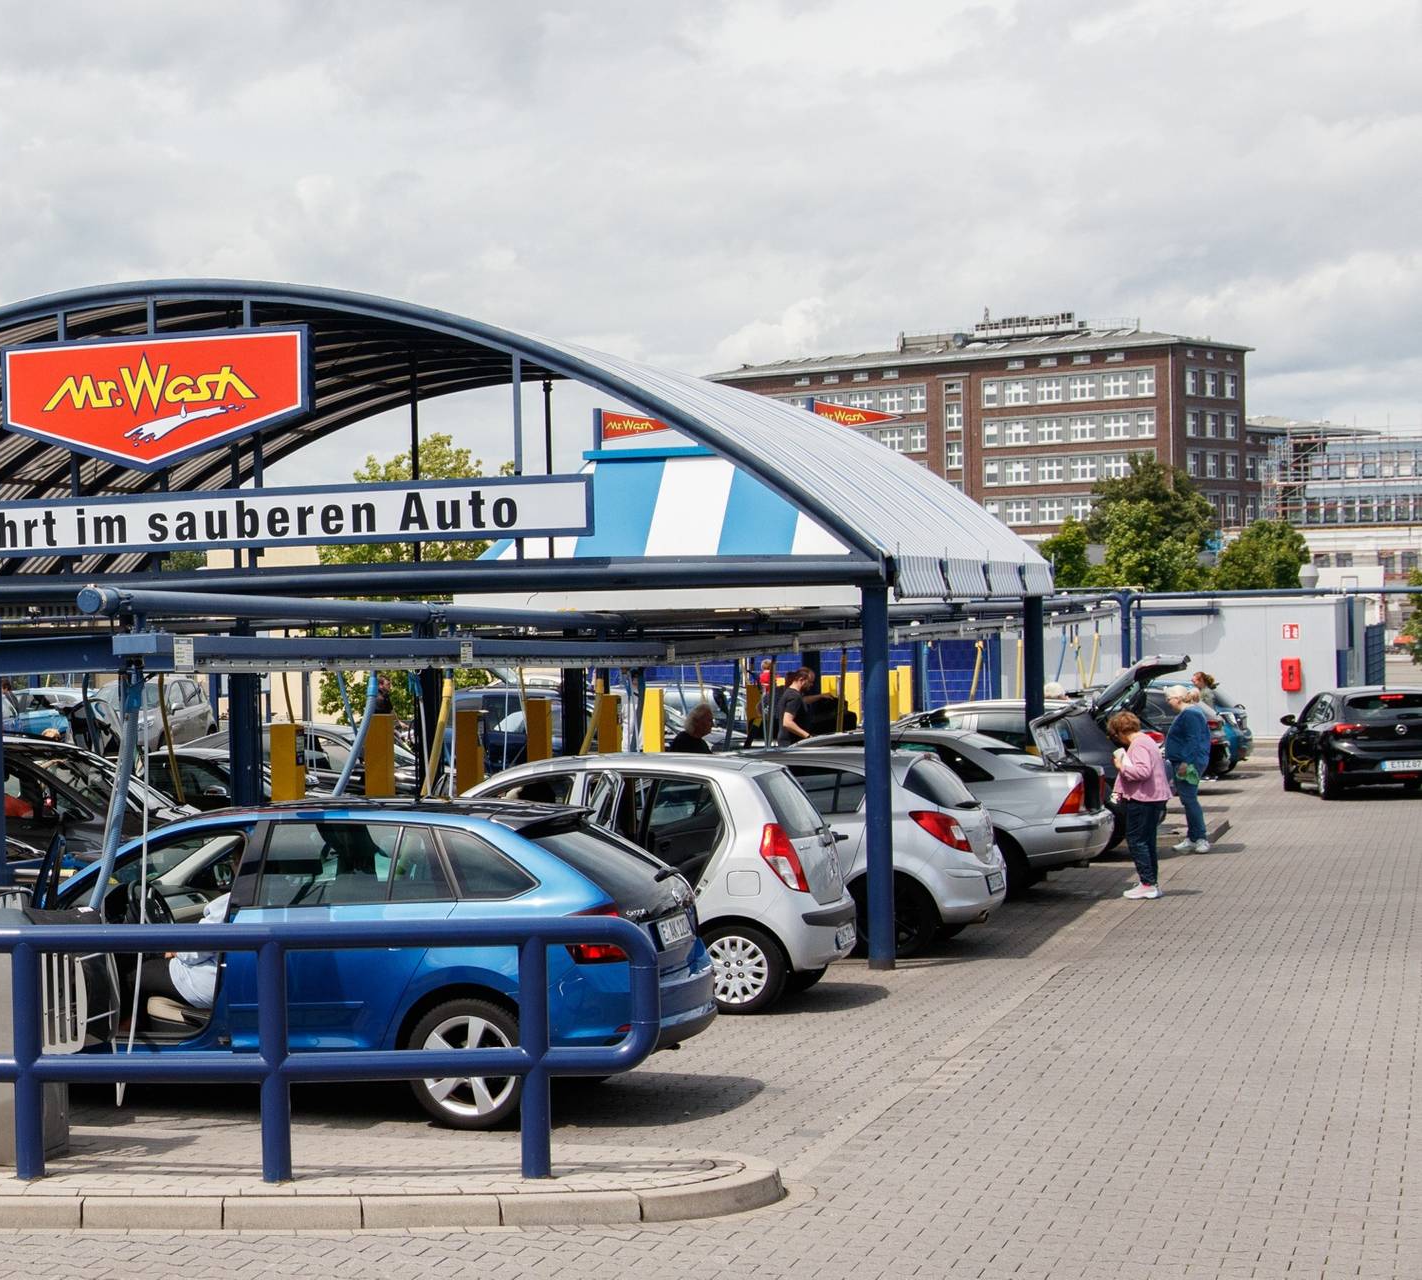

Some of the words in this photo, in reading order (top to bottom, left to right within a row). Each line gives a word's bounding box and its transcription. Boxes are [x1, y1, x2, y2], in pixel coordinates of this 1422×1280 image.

[77, 508, 127, 545] im
[148, 500, 376, 543] sauberen
[399, 490, 518, 531] Auto
